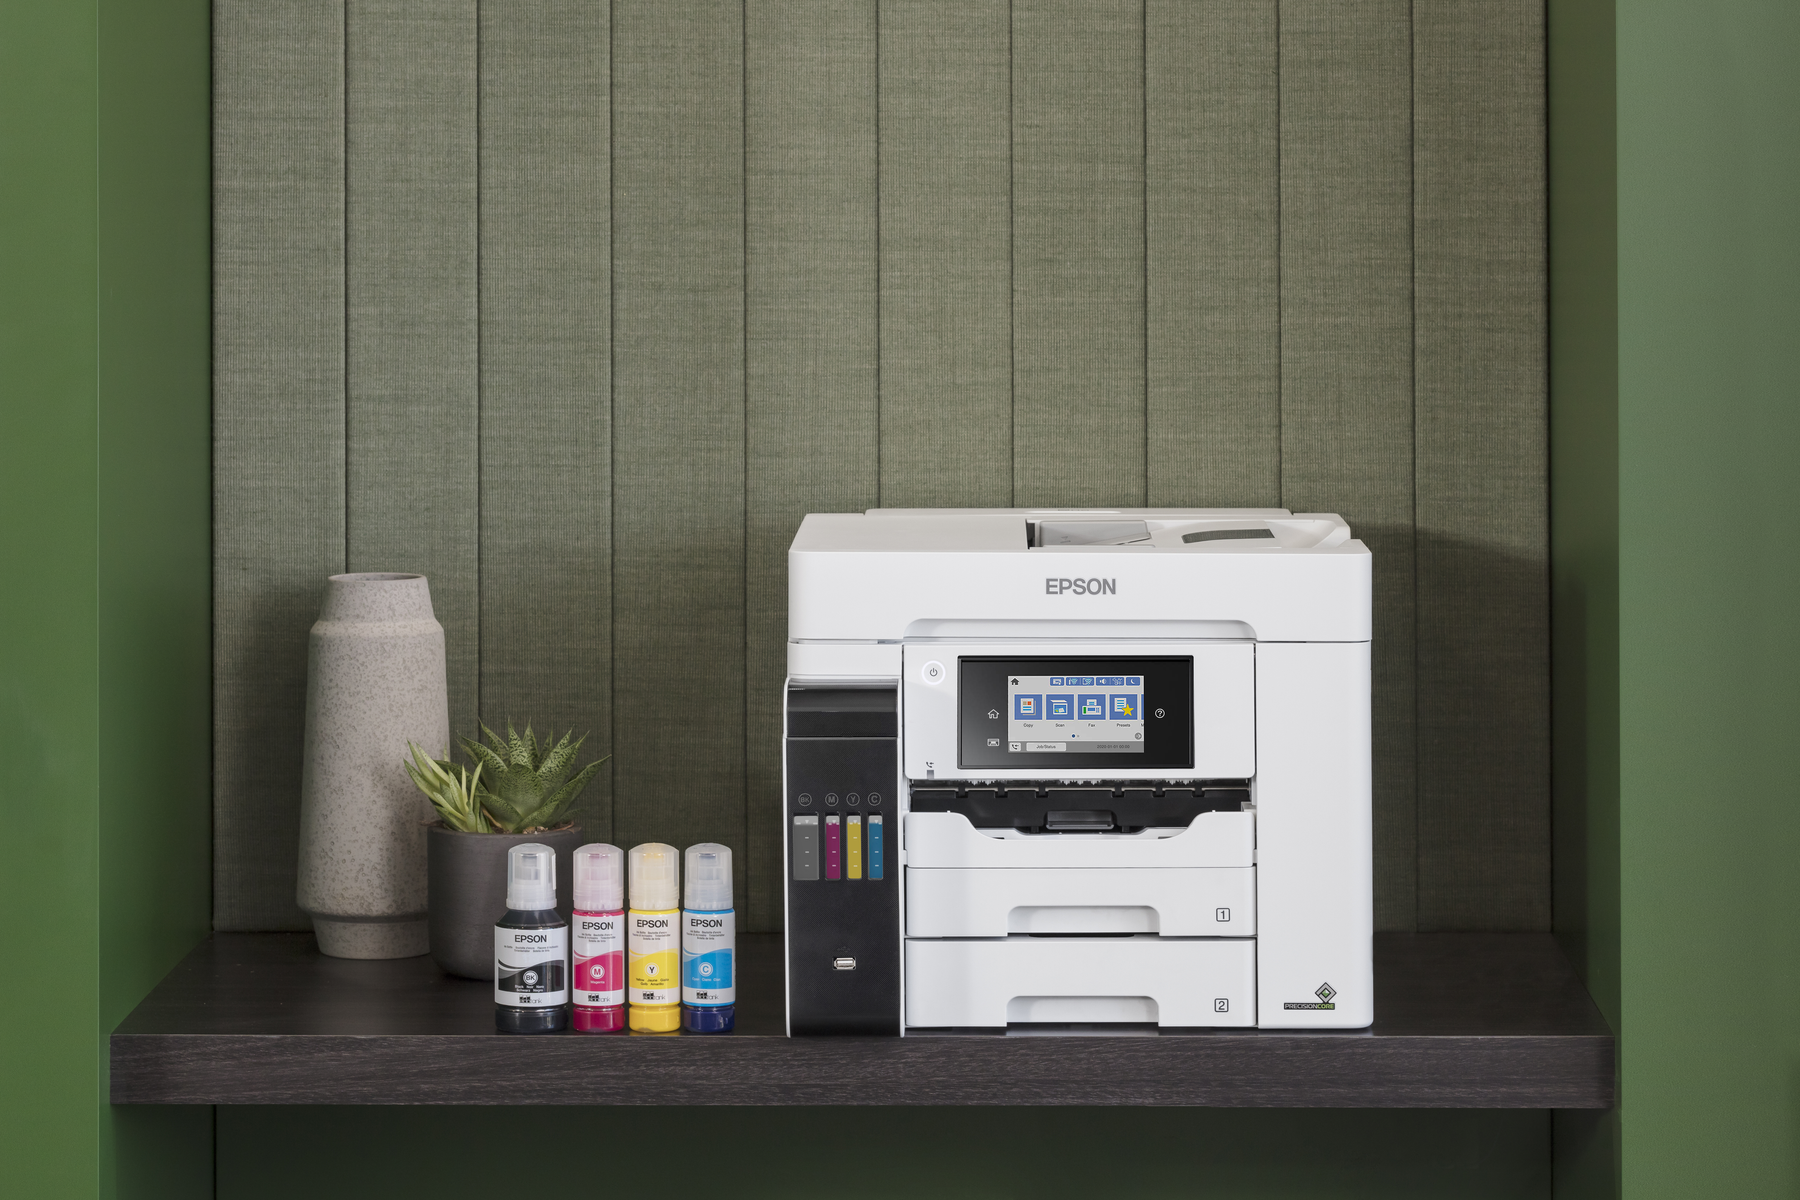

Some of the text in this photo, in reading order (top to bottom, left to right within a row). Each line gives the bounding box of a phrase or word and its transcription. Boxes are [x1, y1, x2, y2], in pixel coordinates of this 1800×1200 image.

[1045, 577, 1116, 595] EPSON
[582, 921, 614, 930] EPSON
[636, 919, 669, 928] EPSON
[690, 918, 723, 928] EPSON
[514, 934, 547, 943] EPSON
